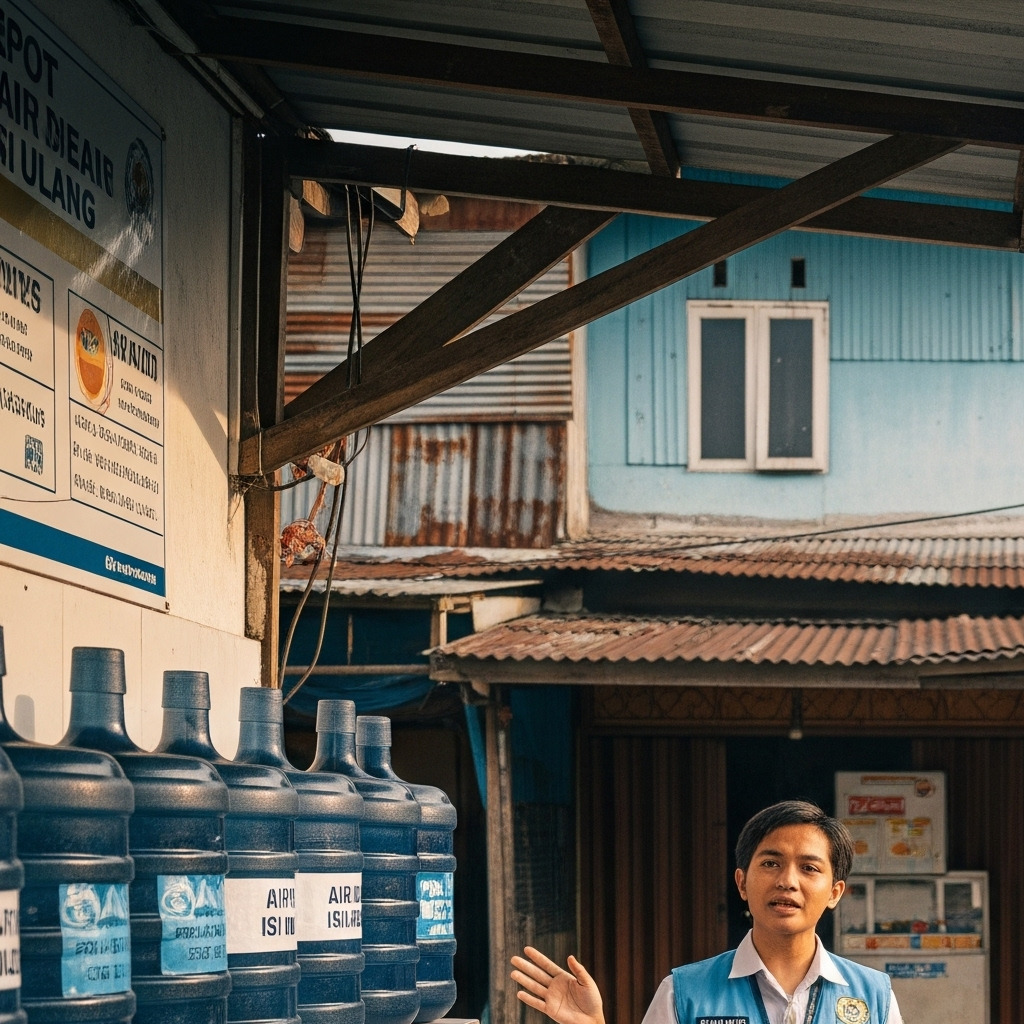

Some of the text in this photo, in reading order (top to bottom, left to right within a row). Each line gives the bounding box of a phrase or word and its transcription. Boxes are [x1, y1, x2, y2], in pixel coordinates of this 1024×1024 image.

[0, 70, 39, 139] AIR
[21, 139, 95, 229] ULANG
[328, 885, 351, 904] AIR
[261, 916, 282, 937] ISI
